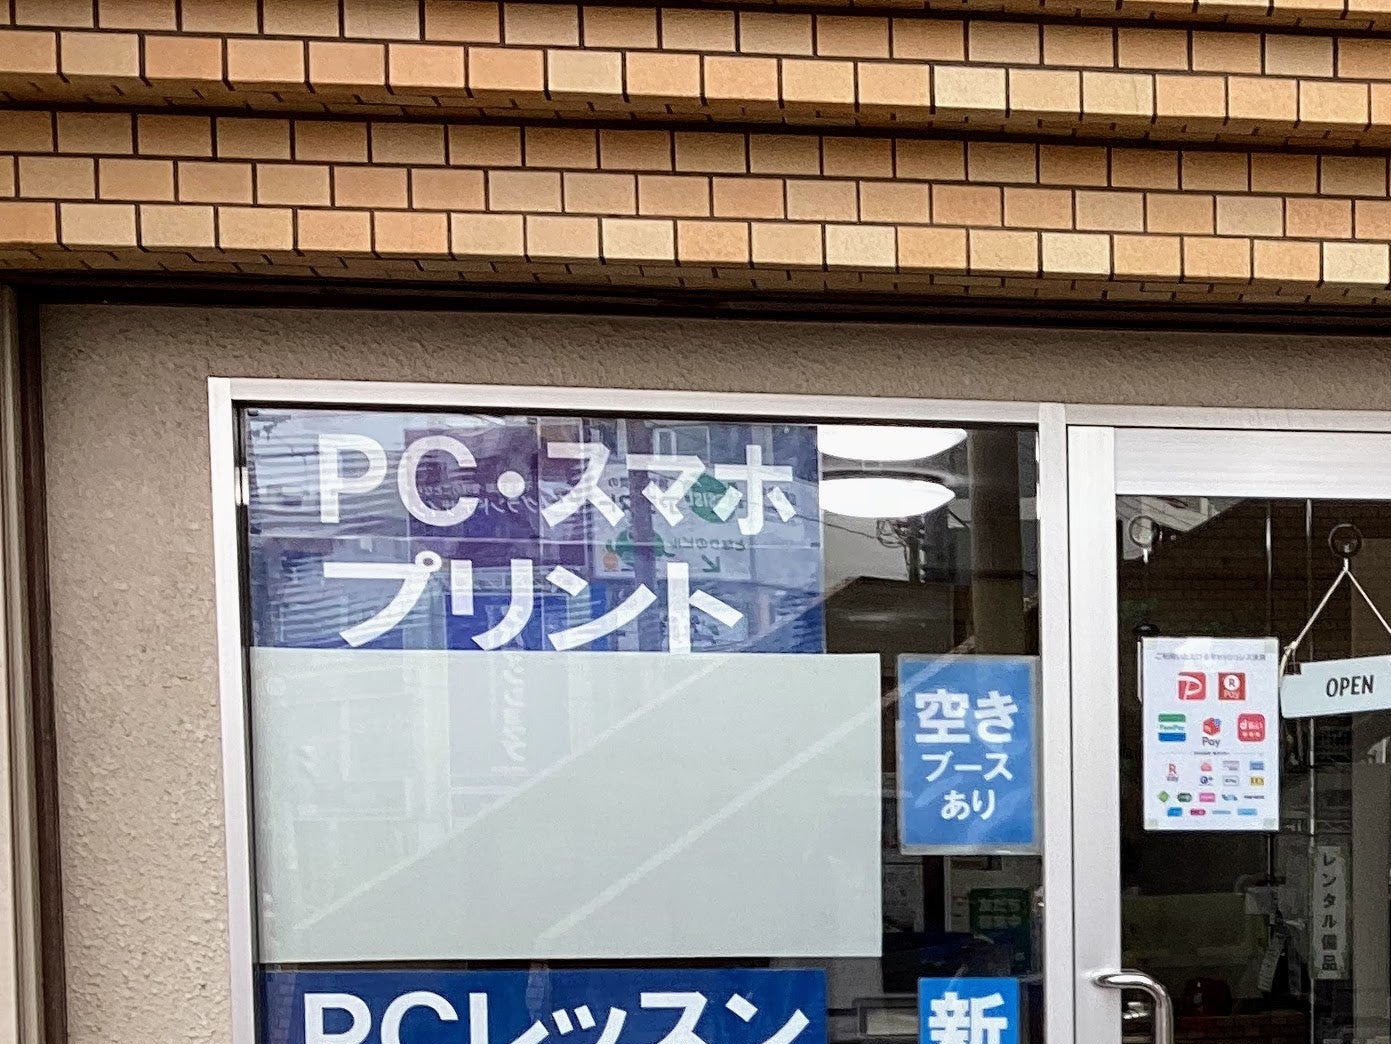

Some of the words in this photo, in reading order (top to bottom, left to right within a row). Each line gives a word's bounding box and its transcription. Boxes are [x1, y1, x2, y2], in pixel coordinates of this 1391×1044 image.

[319, 433, 796, 538] PC・スマホ
[322, 551, 744, 654] プリント
[1325, 674, 1376, 699] OPEN
[914, 688, 1019, 744] 空き
[1202, 736, 1221, 747] Pay
[921, 750, 1014, 782] ブース
[940, 789, 996, 821] あり
